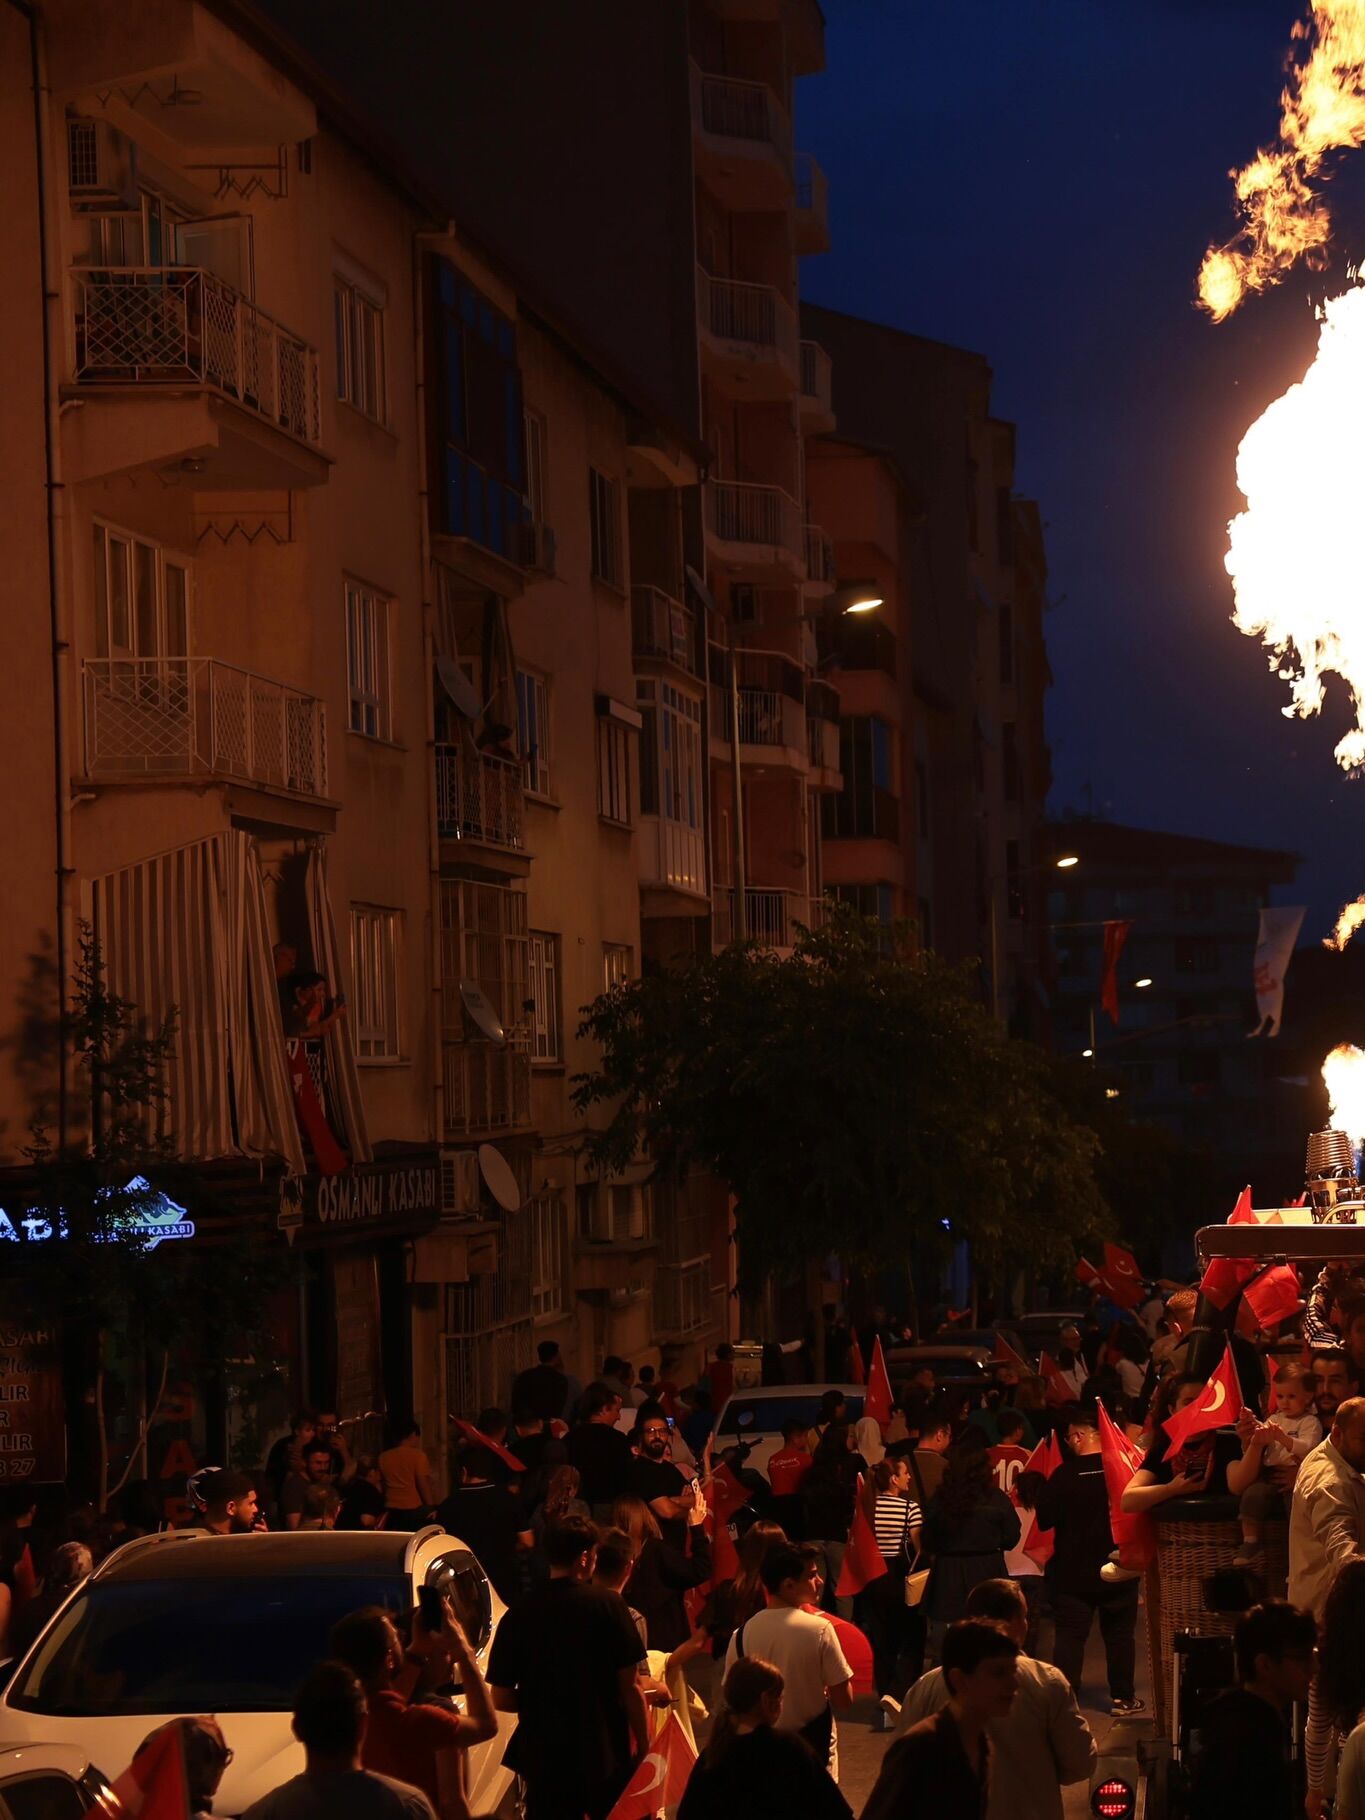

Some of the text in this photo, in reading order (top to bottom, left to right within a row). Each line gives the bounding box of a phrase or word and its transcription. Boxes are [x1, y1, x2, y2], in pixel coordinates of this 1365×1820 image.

[318, 1167, 436, 1223] OSMANLI KASABI
[148, 1224, 190, 1235] KASABI
[10, 1457, 36, 1477] 27
[992, 1459, 1026, 1495] 10
